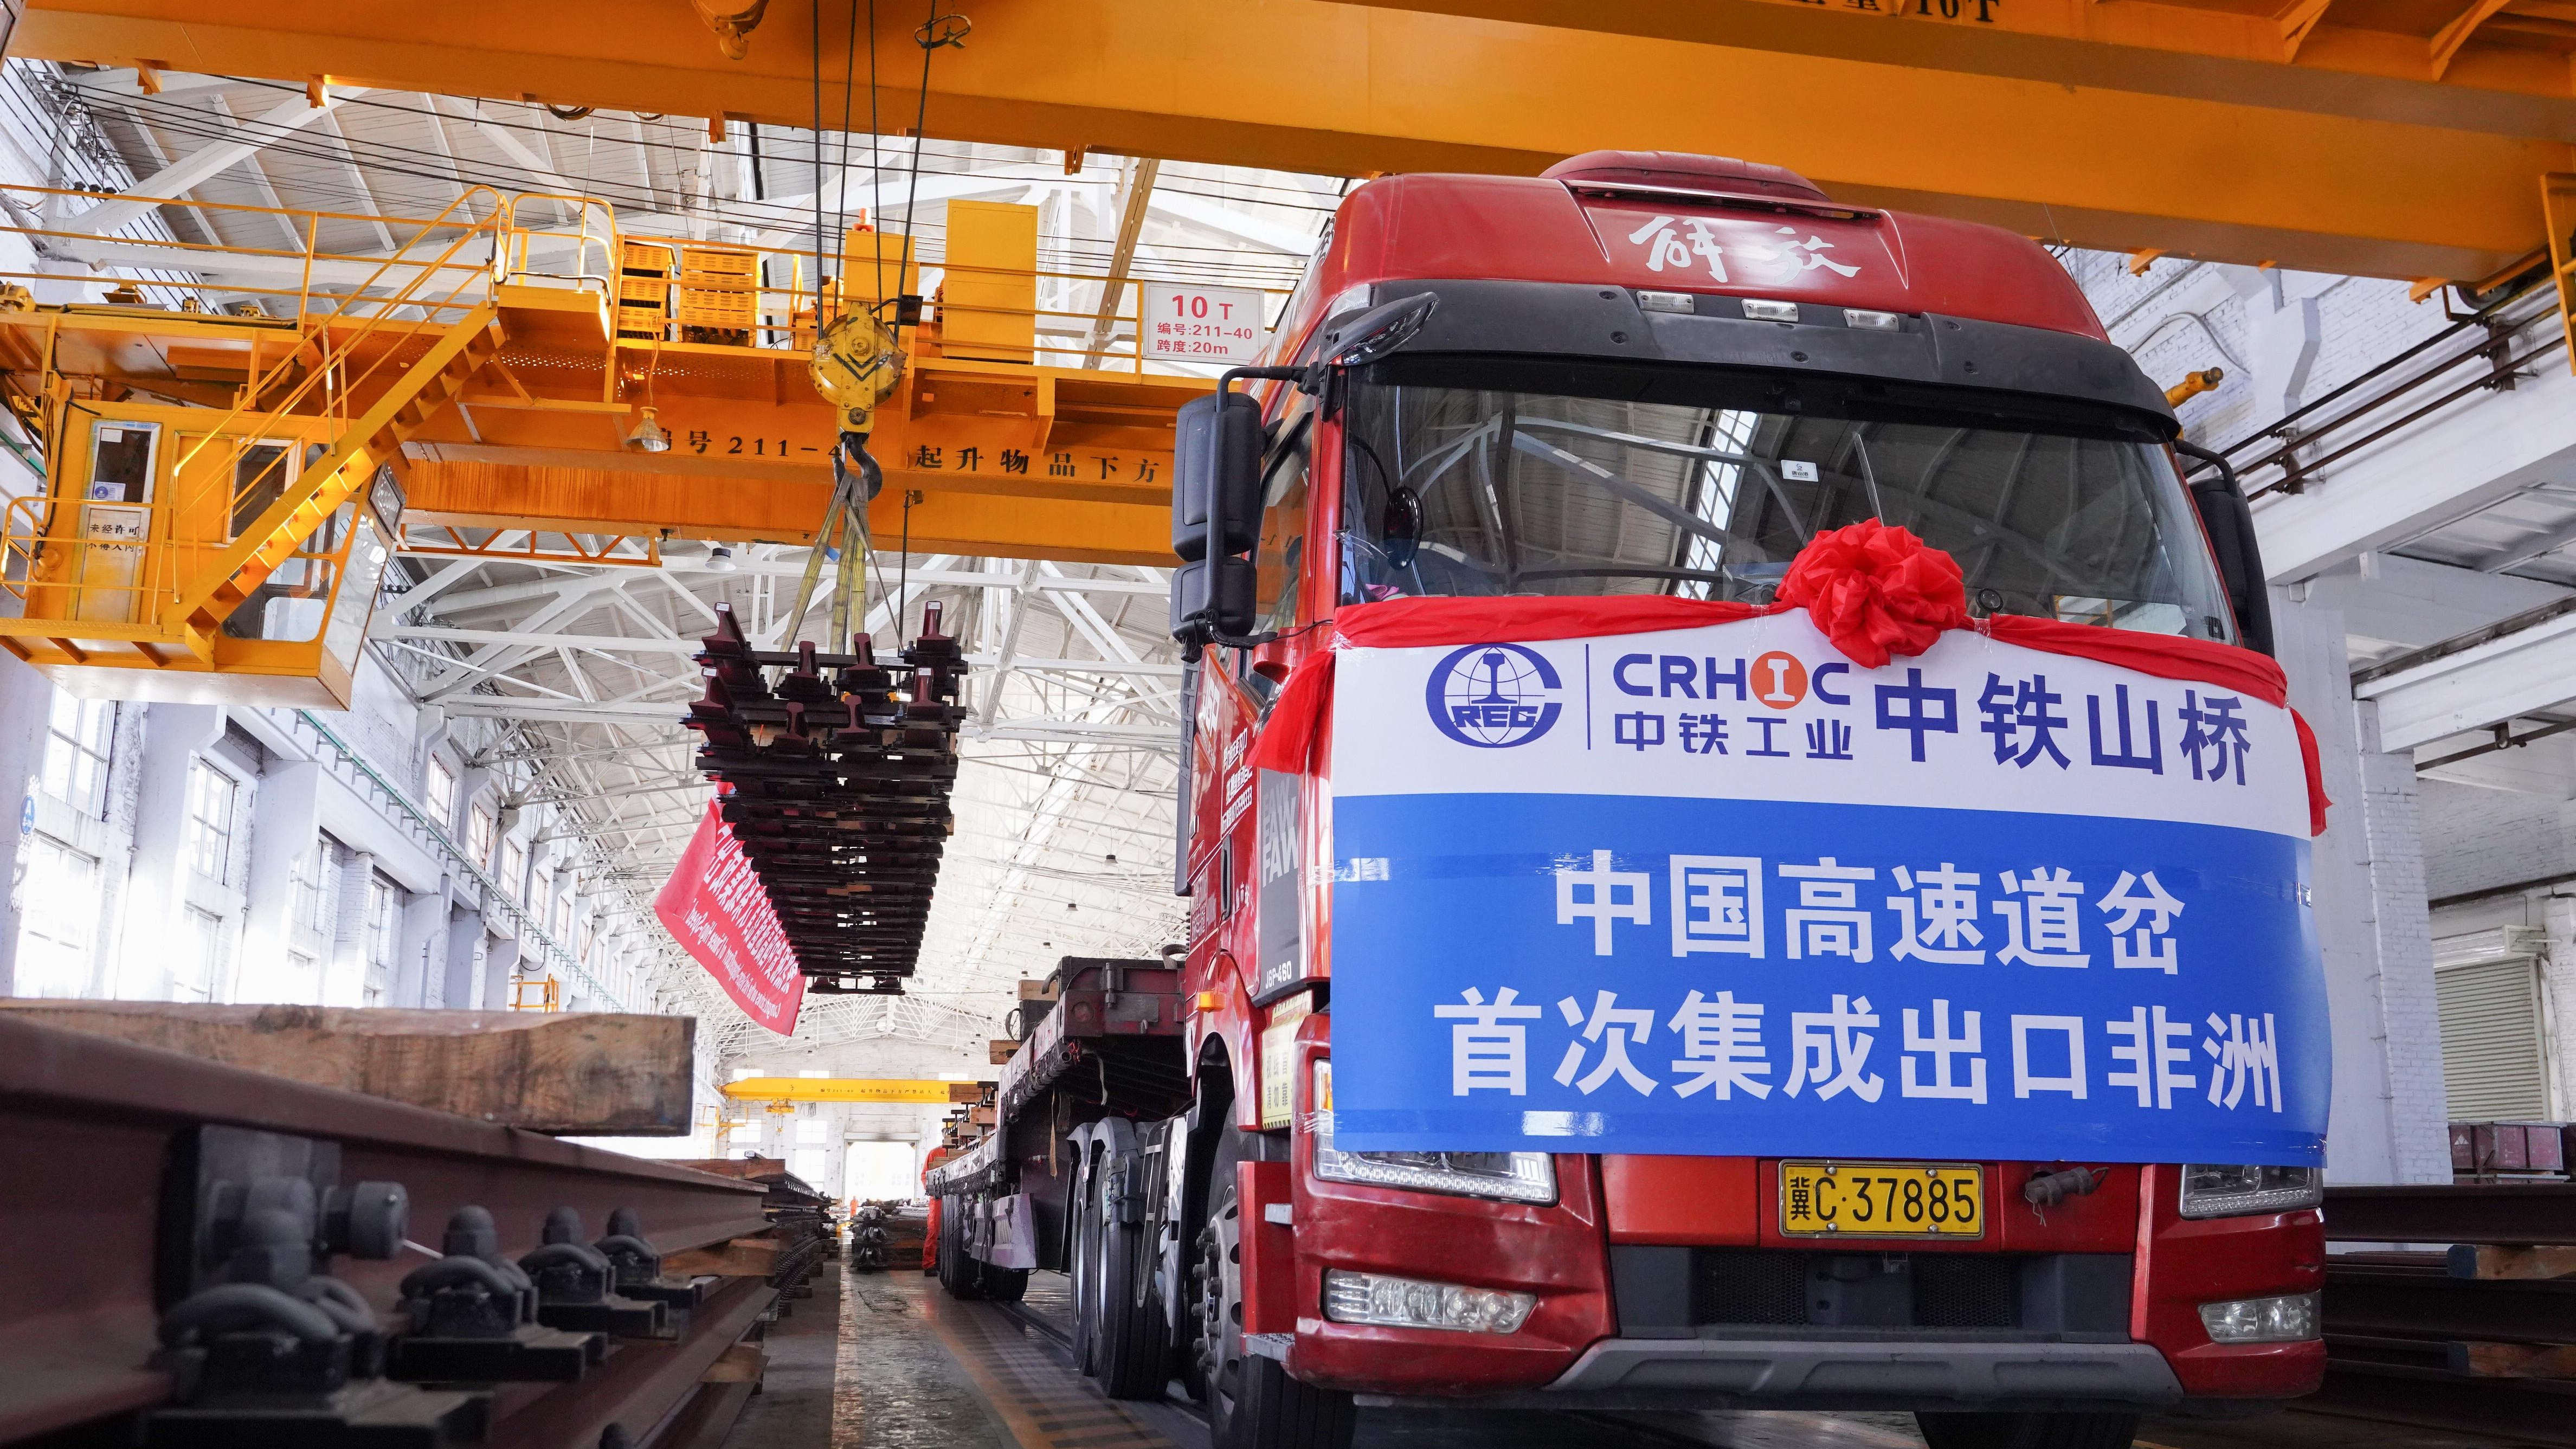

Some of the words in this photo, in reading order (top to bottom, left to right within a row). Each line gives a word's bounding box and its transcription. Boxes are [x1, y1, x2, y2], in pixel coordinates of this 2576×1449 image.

[1172, 295, 1208, 318] 10
[1219, 303, 1233, 320] T
[1157, 339, 1228, 354] 跨度:20m
[915, 445, 1160, 482] 起升物品下方
[89, 524, 139, 535] 未经许可
[1615, 711, 1853, 760] 中铁工业
[1874, 668, 2251, 785] 中铁山桥
[1263, 826, 1298, 887] FAW
[1555, 849, 2185, 975] 中国高速道岔
[1265, 961, 1291, 989] J6P-460
[1434, 987, 2283, 1114] 首次集成出口非洲
